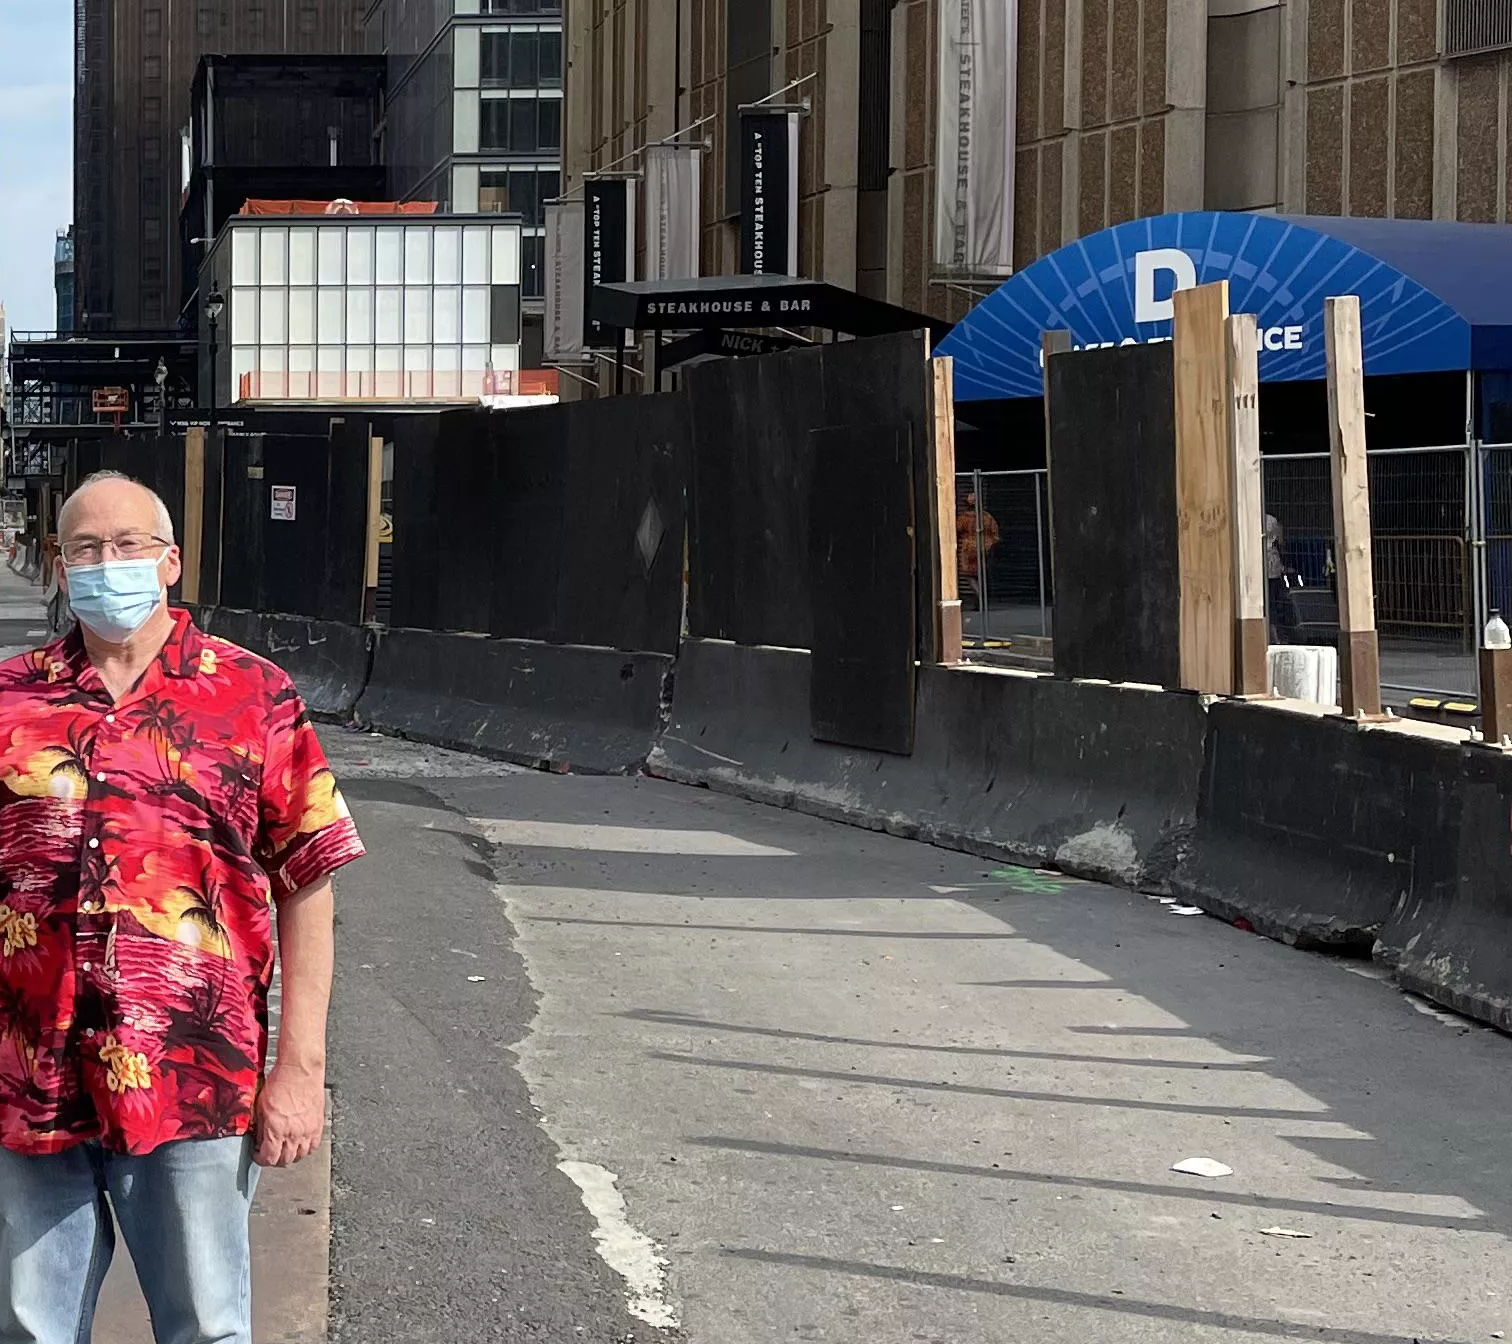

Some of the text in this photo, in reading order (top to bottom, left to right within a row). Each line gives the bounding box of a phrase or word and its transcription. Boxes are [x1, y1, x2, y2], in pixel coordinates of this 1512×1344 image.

[956, 54, 971, 188] STEAKHOUSE
[754, 171, 763, 194] TEN
[753, 197, 764, 276] STEAKHOUS
[647, 299, 811, 314] STEAKHOUSE & BAR
[1135, 248, 1197, 323] D
[720, 334, 764, 353] NICK
